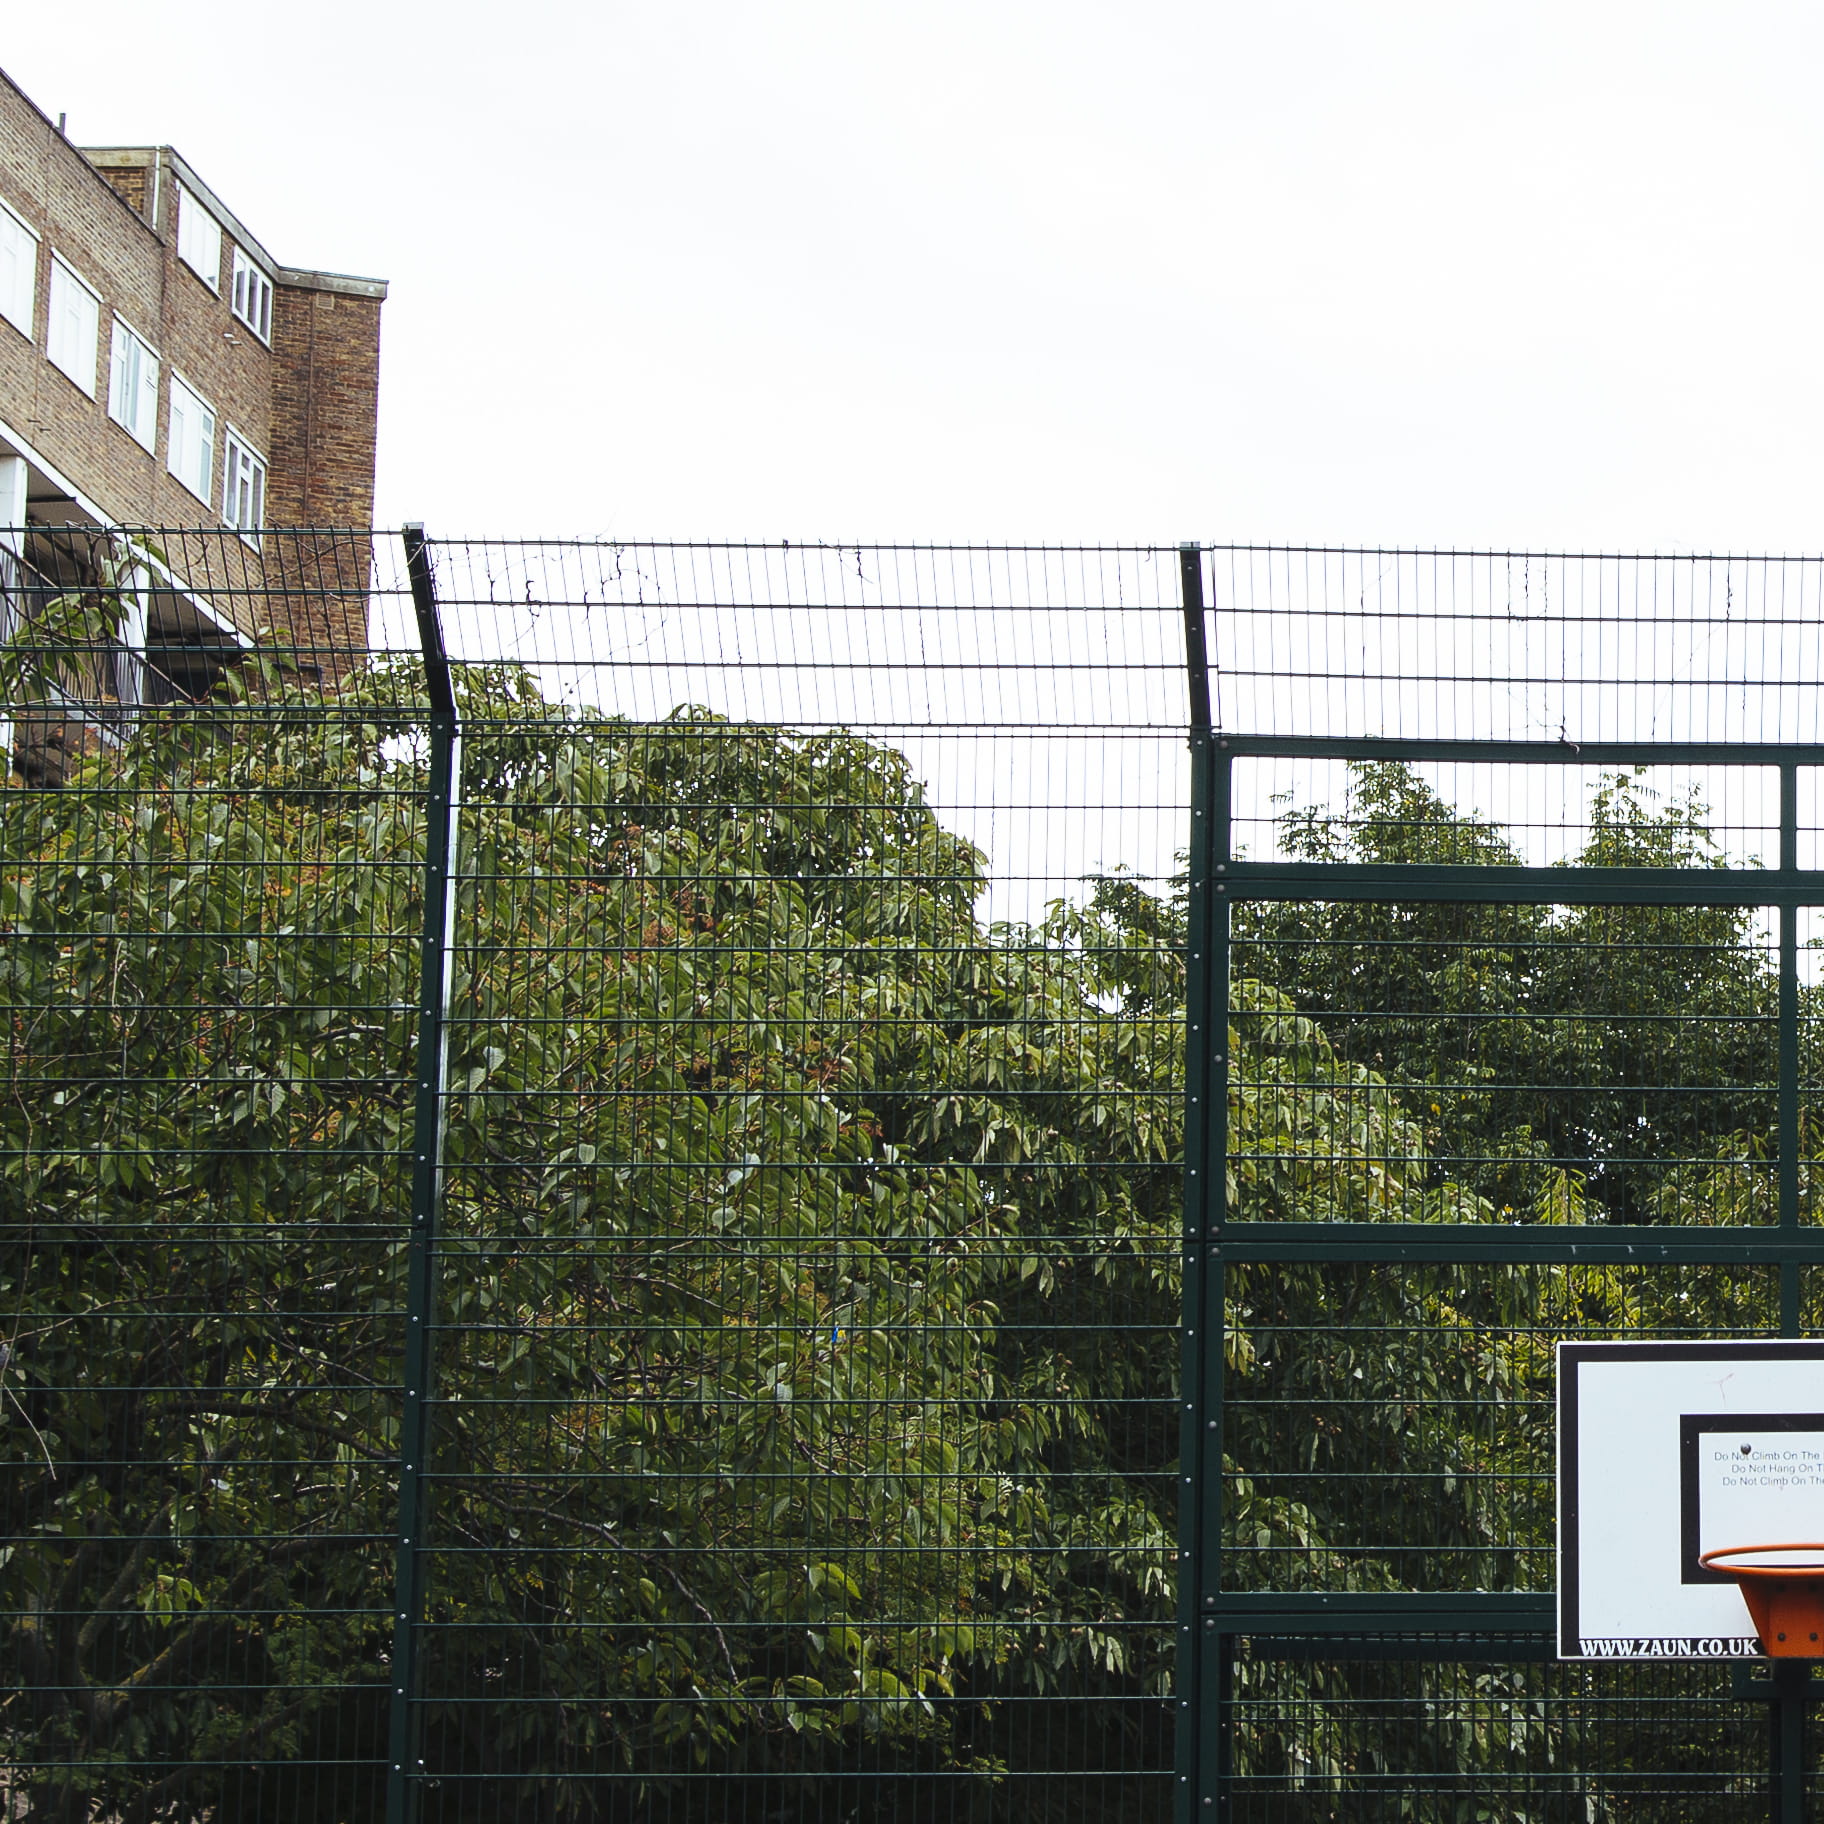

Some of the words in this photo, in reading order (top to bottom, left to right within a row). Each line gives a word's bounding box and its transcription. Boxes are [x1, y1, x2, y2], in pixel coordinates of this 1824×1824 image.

[1714, 1451, 1729, 1461] Do
[1731, 1451, 1750, 1461] Not
[1751, 1451, 1781, 1461] Climb
[1782, 1451, 1799, 1461] On
[1802, 1451, 1821, 1461] The
[1731, 1464, 1746, 1475] Do
[1749, 1464, 1767, 1475] Not
[1769, 1464, 1796, 1475] Hang
[1798, 1464, 1814, 1475] On
[1722, 1476, 1737, 1486] Do
[1739, 1476, 1758, 1486] Not
[1760, 1476, 1789, 1486] Climb
[1791, 1476, 1807, 1486] On
[1579, 1639, 1758, 1656] WWW.ZAUN.CO.UK
